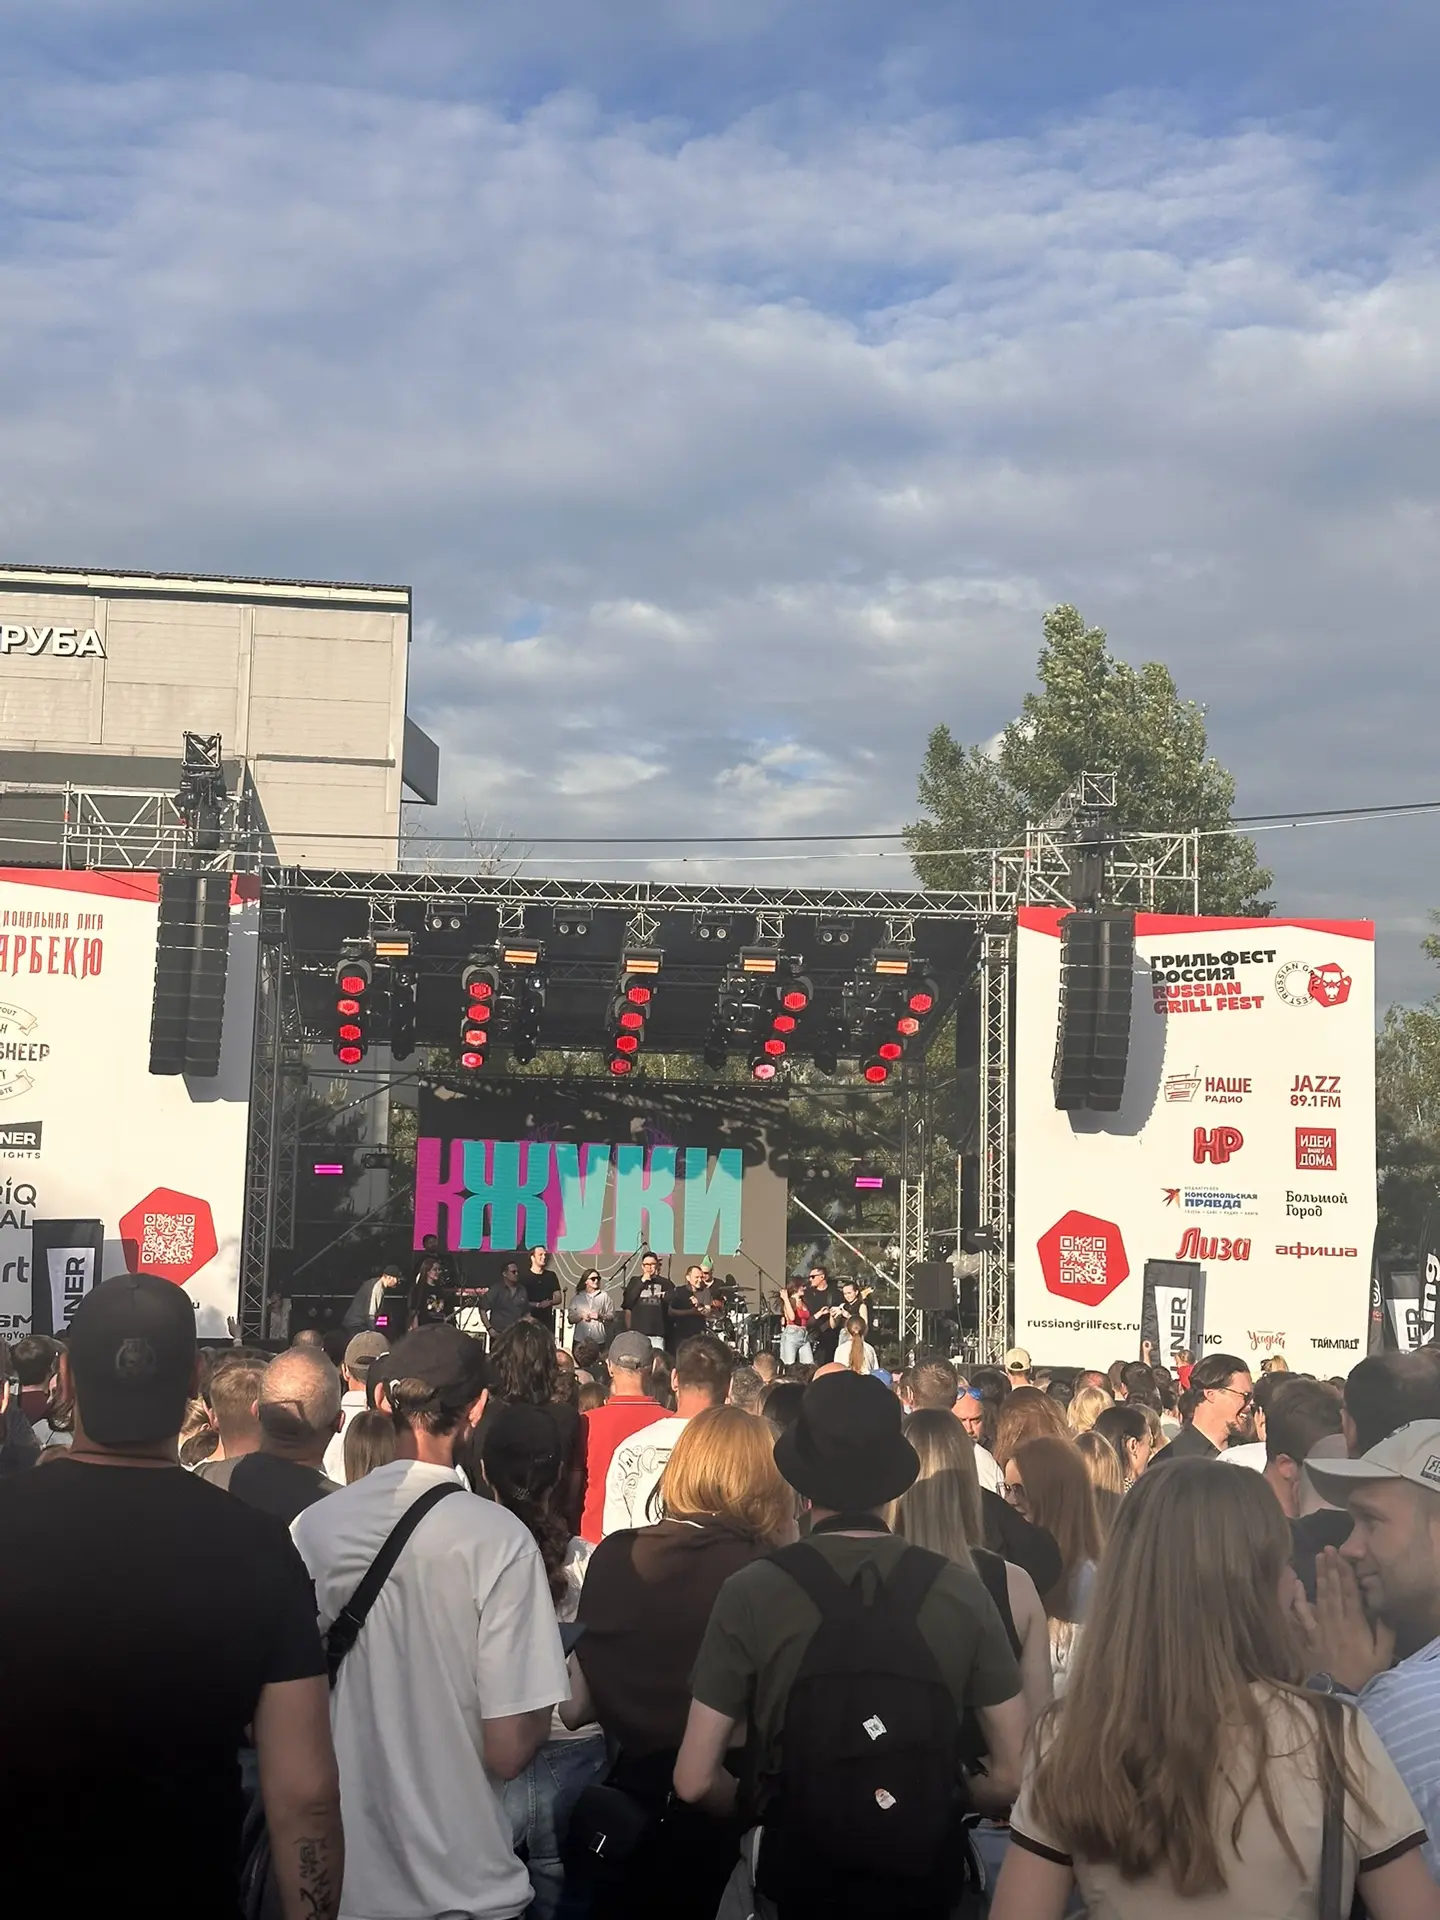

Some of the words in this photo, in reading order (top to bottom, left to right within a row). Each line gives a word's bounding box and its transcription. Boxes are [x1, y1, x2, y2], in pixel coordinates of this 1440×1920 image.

[0, 625, 108, 659] РУБА
[1150, 949, 1277, 969] ГРИЛЬФЕСТ
[1152, 967, 1236, 984] РОССИЯ
[1152, 981, 1242, 999] RUSSIAN
[1153, 998, 1212, 1015] GRILL
[1216, 995, 1265, 1011] FEST
[1205, 1076, 1253, 1093] НАШЕ
[1290, 1074, 1341, 1093] JAZZ
[1205, 1095, 1243, 1105] РАДИО
[1300, 1134, 1332, 1148] ИДЕИ
[1299, 1153, 1334, 1167] ДОМА
[1184, 1191, 1258, 1200] КОМСОМОЛЬСКАЯ
[1286, 1189, 1349, 1204] Большой
[1184, 1199, 1242, 1210] ПРАВДА
[1286, 1204, 1323, 1219] Город
[1175, 1227, 1251, 1261] Лиза
[1275, 1242, 1358, 1259] афиша
[1027, 1318, 1141, 1331] russiangrillfest.ru
